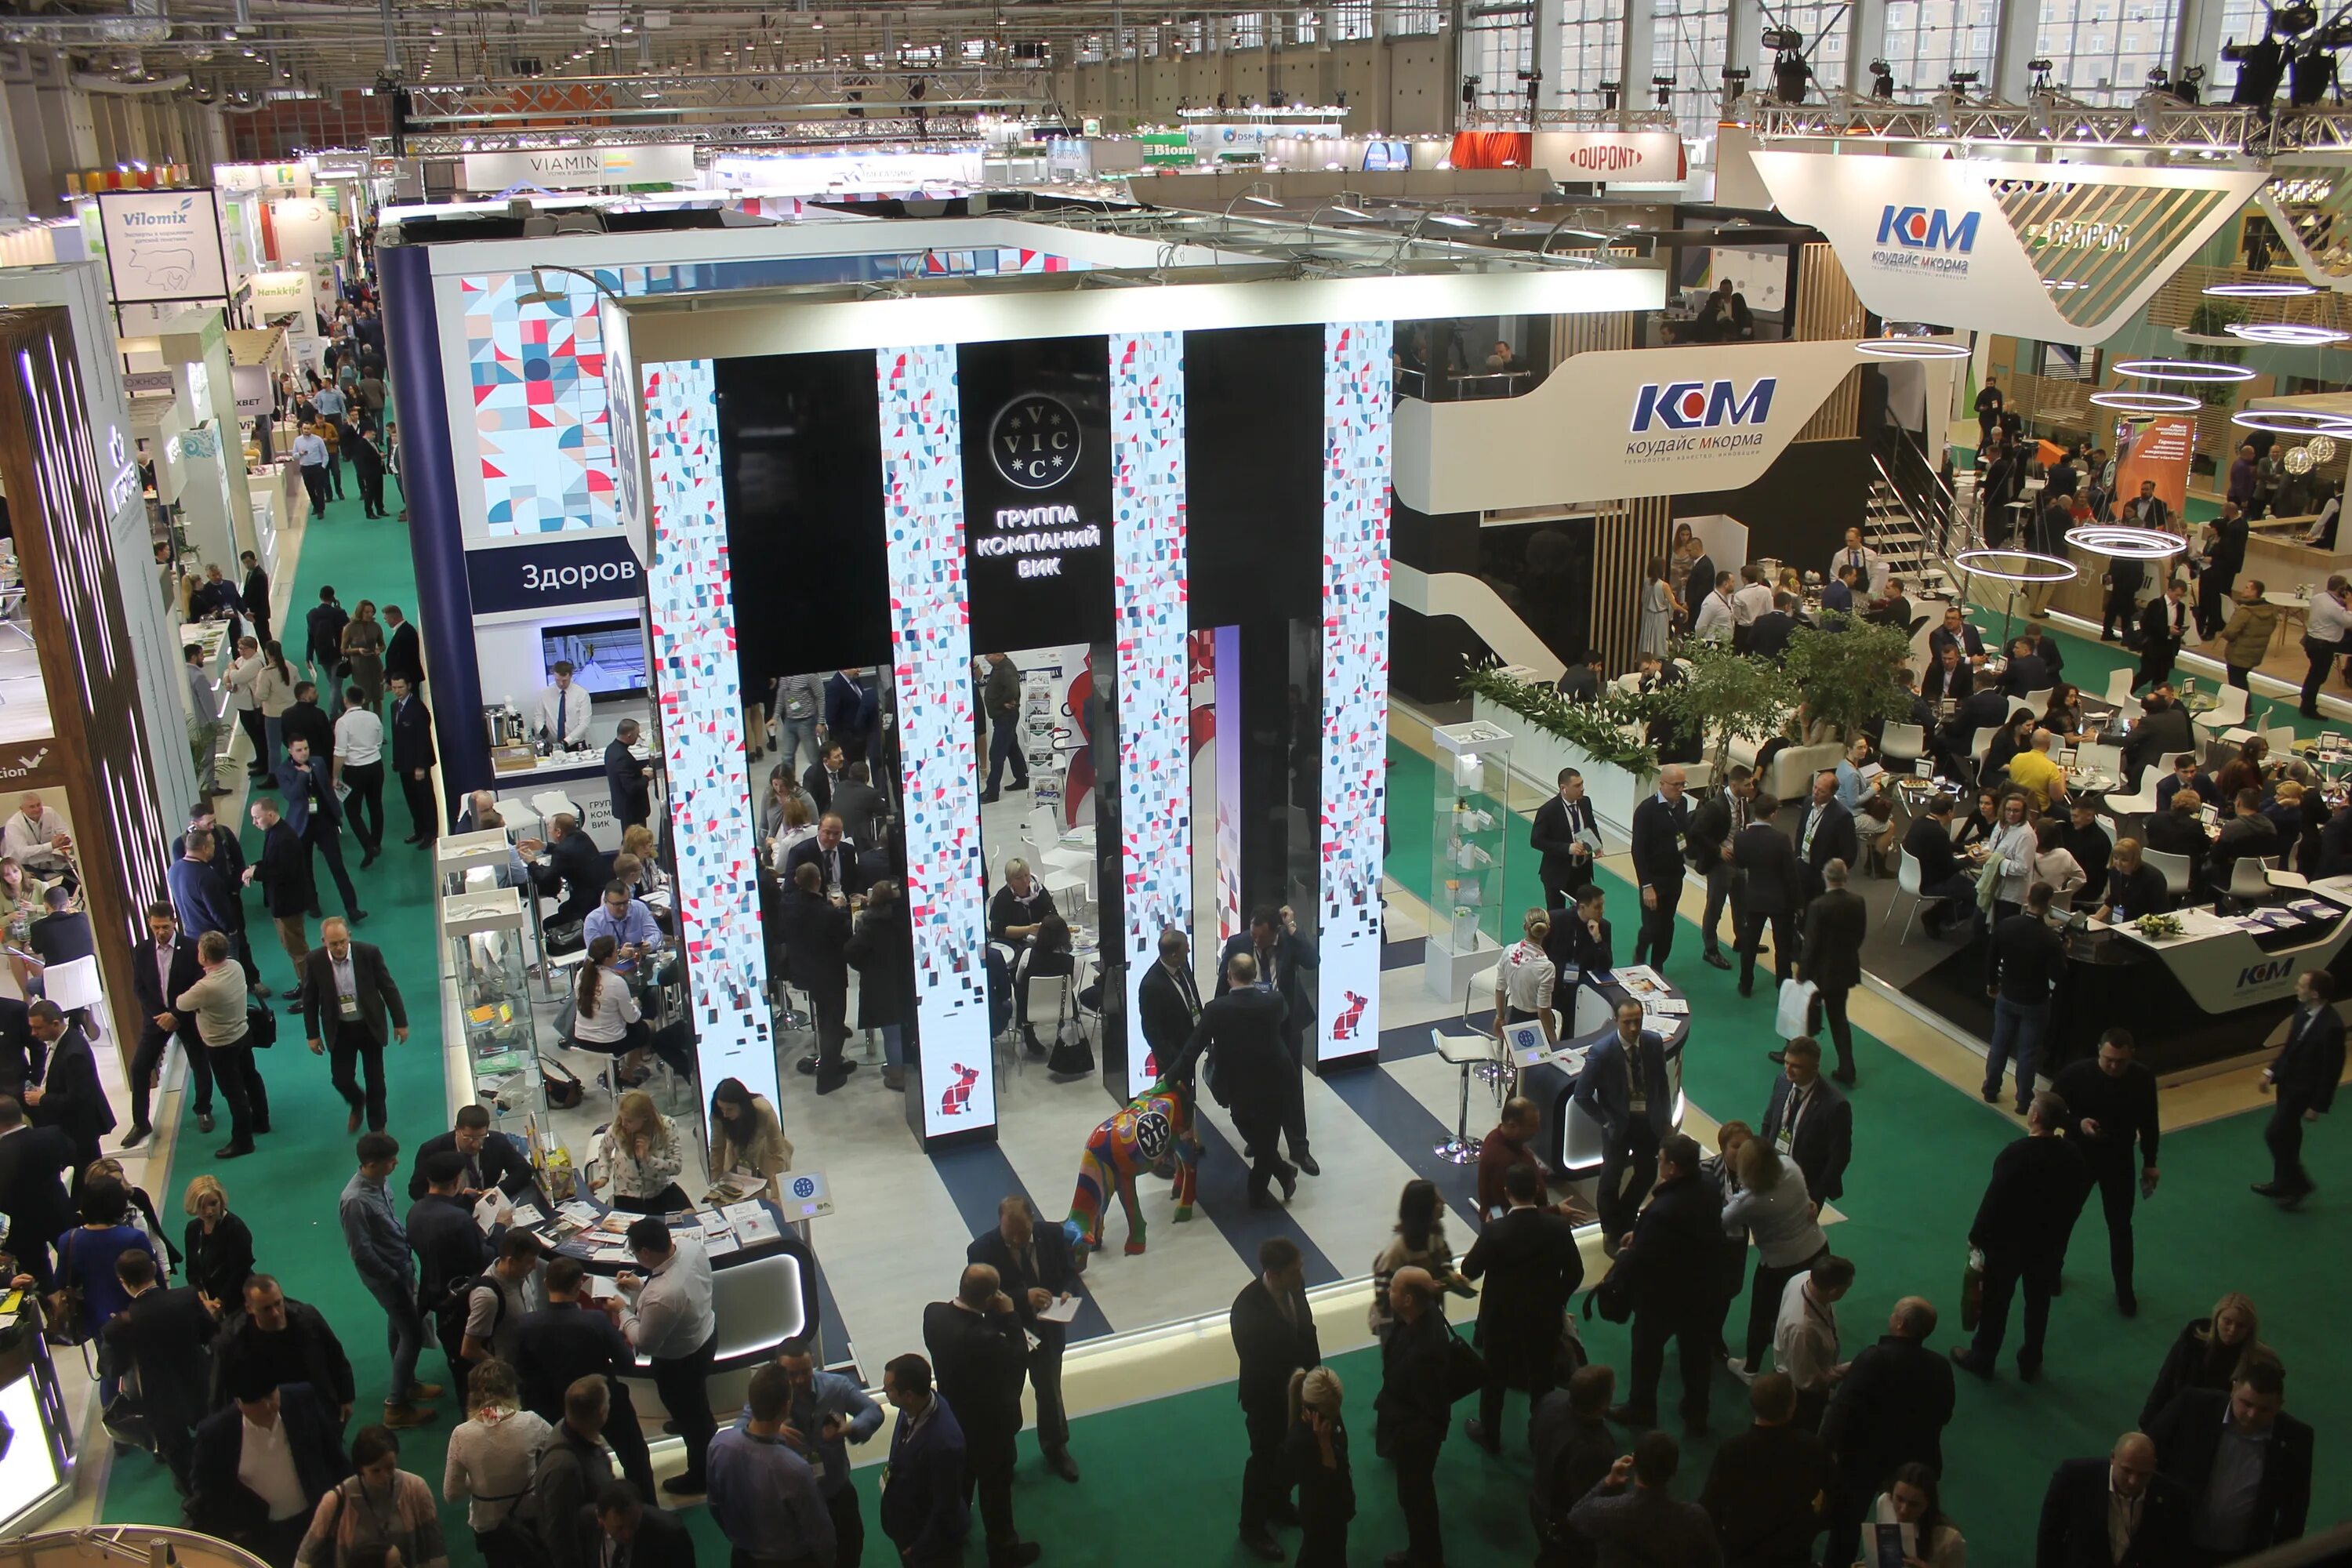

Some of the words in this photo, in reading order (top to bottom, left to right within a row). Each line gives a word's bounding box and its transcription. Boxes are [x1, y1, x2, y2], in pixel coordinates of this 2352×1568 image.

[531, 156, 598, 171] VIAMIN
[1579, 146, 1635, 170] DUPONT
[123, 211, 187, 226] Vilomix
[257, 287, 301, 297] Hankkija
[1626, 435, 1696, 457] коудайс
[1699, 433, 1762, 450] мкорма
[996, 505, 1079, 529] ГРУППА
[977, 524, 1101, 557] КОМПАНИЙ
[521, 561, 636, 591] Здоров
[1018, 557, 1062, 579] ВИК
[592, 820, 610, 829] ВИК
